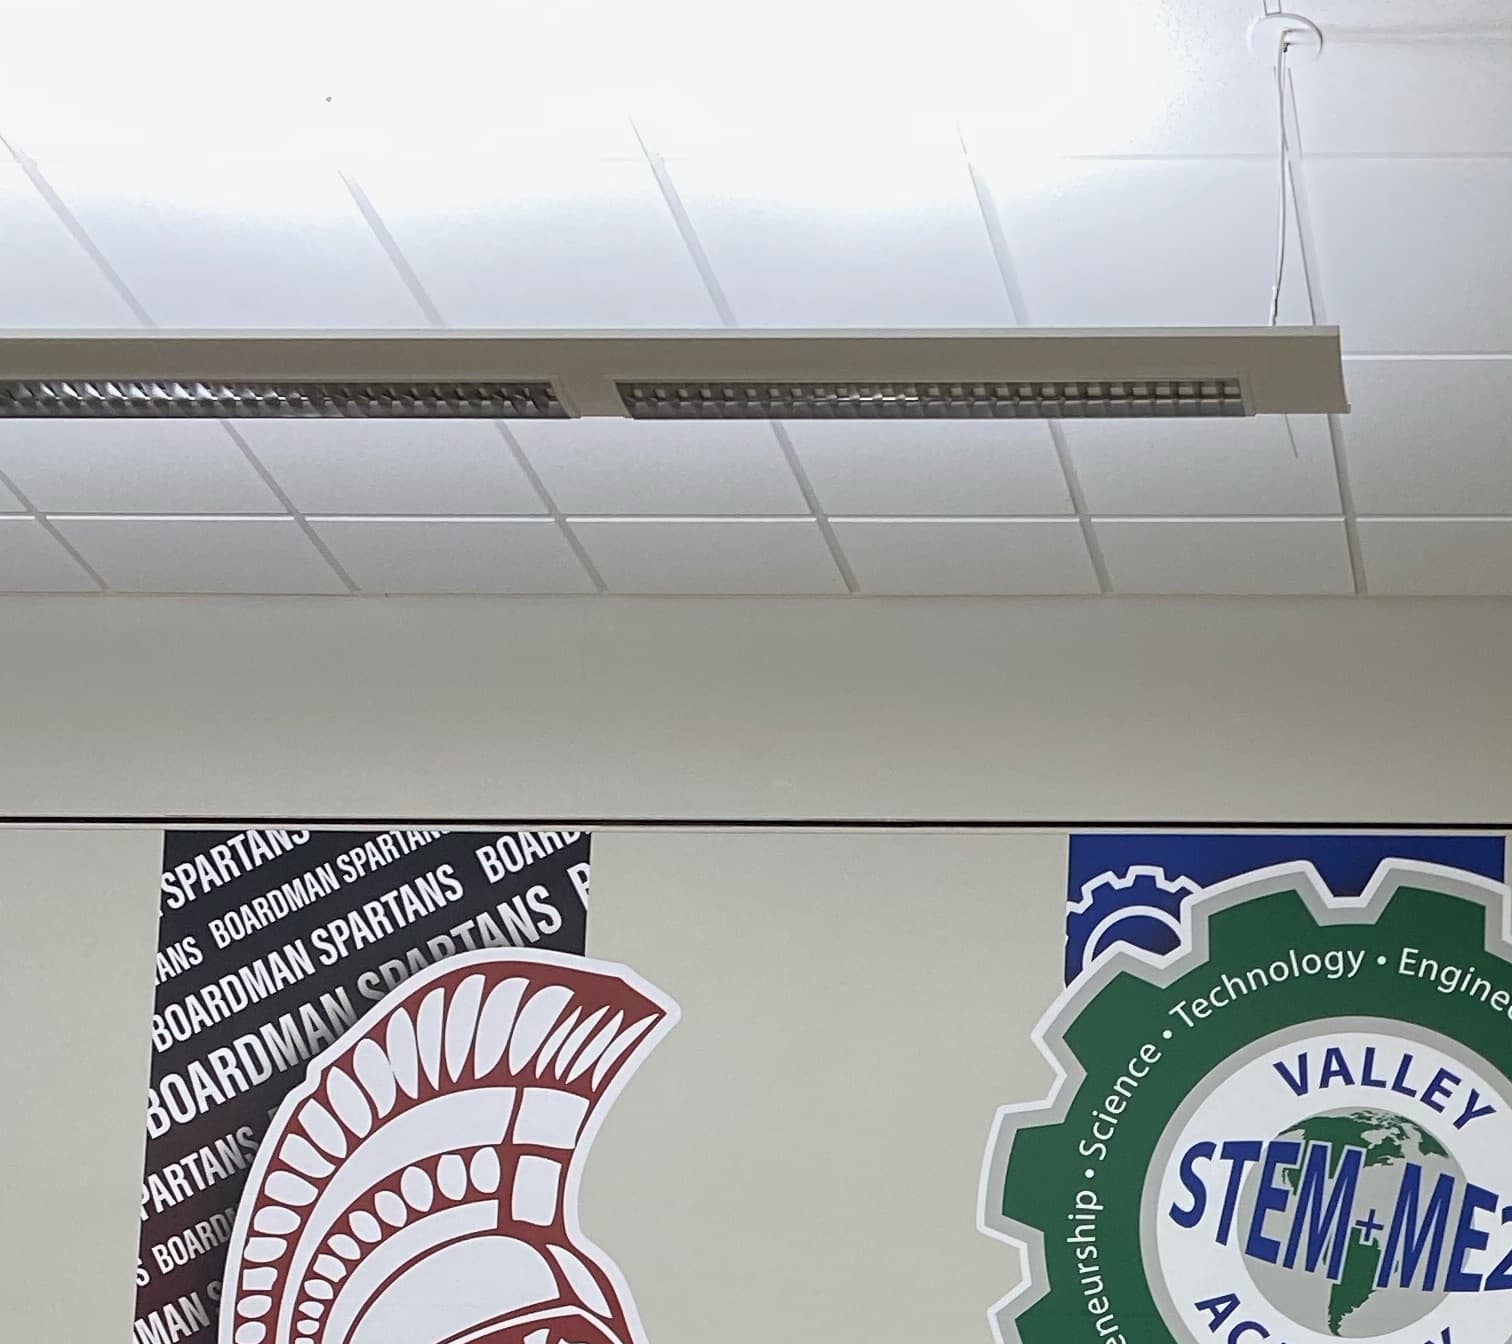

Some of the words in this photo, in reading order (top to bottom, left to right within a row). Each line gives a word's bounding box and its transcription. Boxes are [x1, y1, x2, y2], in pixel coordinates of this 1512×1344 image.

[152, 939, 316, 1052] BOARDMAN
[311, 864, 464, 966] SPARTANS
[155, 936, 203, 985] ANS
[208, 862, 341, 949] BOARDMAN
[336, 830, 450, 884] SPARTA
[147, 986, 358, 1139] BOARDMAN
[1078, 1043, 1162, 1161] Science
[1168, 949, 1366, 1028] Technology
[1273, 1046, 1496, 1130] VALLEY
[152, 1207, 235, 1274] BOARD
